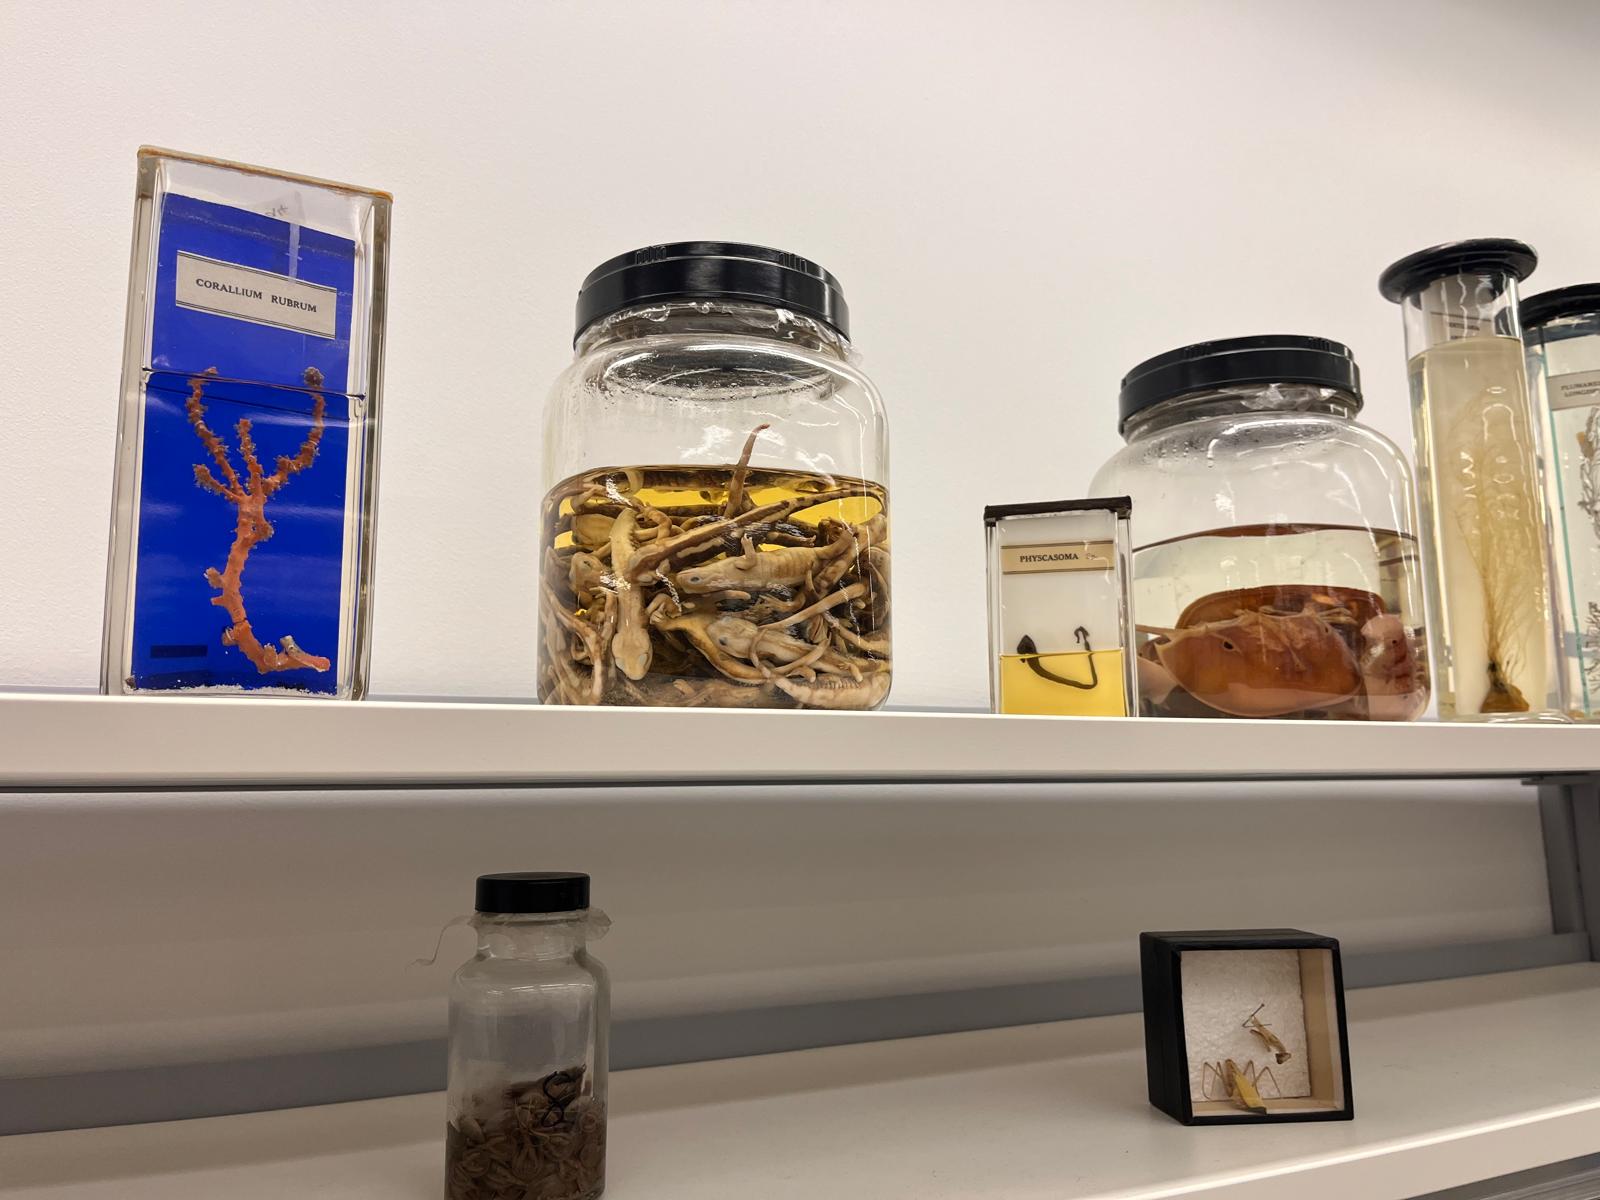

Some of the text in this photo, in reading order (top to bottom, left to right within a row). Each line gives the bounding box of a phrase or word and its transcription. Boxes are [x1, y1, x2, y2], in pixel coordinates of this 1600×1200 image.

[195, 278, 318, 313] CORALLIUM RUBRUM
[1019, 553, 1079, 563] PHYSCASOMA
